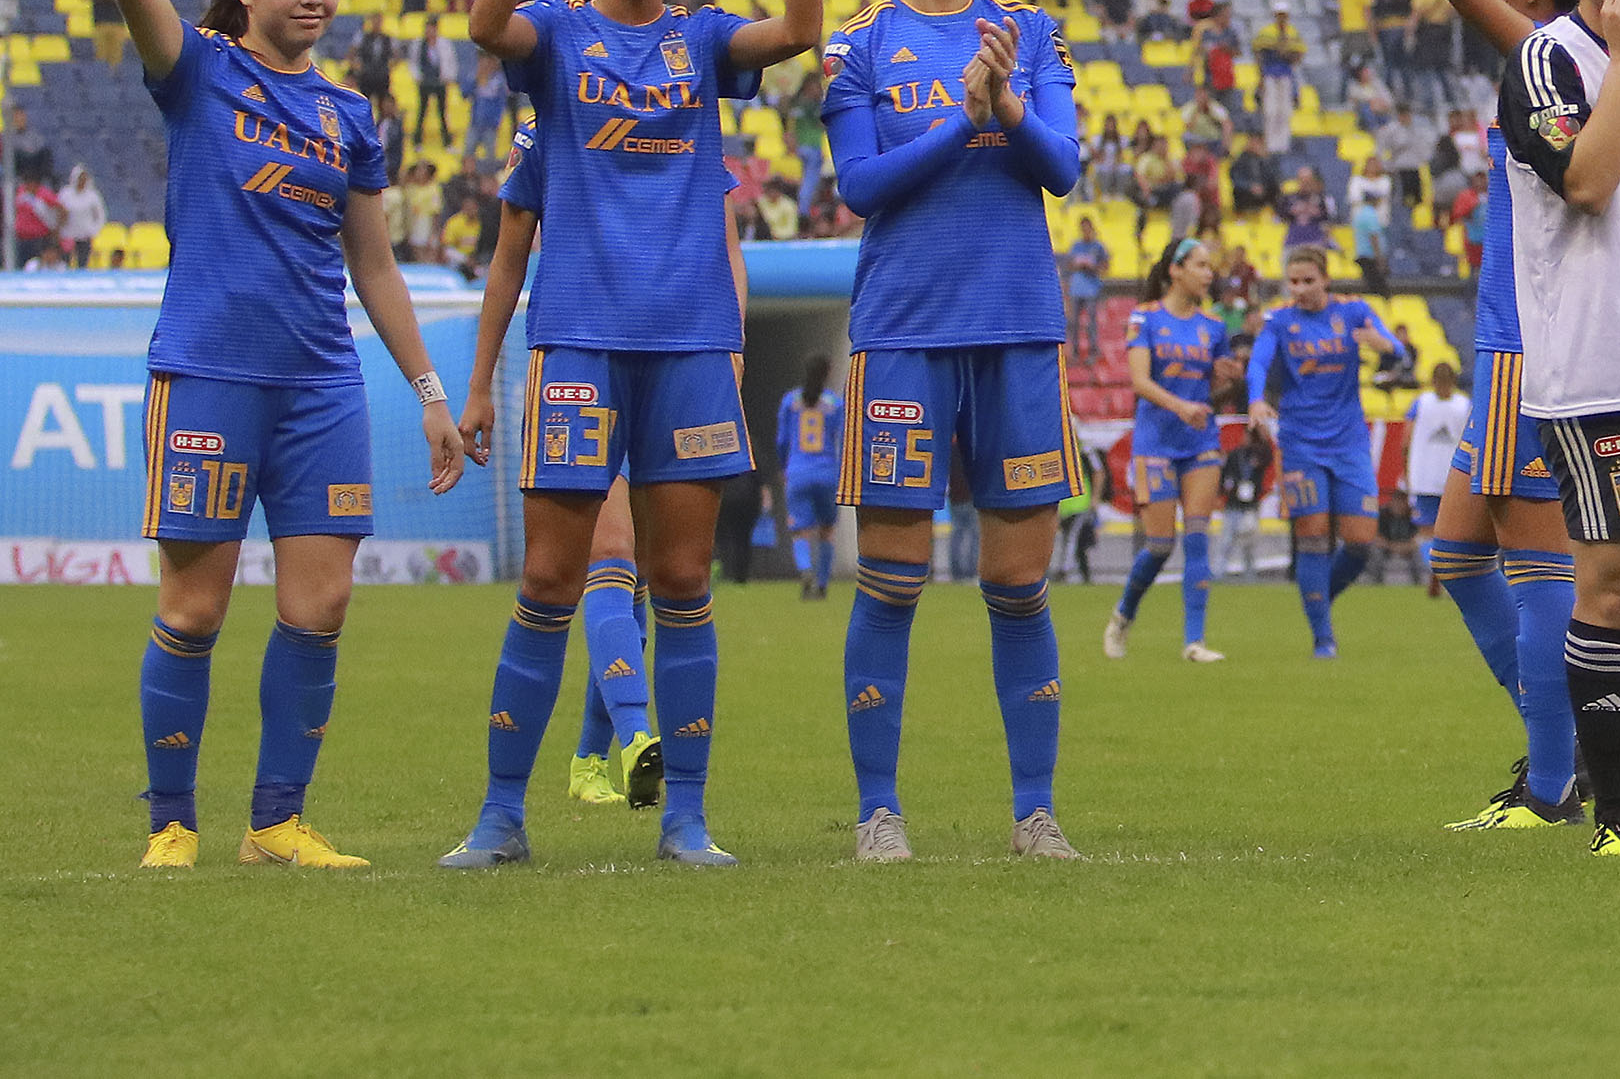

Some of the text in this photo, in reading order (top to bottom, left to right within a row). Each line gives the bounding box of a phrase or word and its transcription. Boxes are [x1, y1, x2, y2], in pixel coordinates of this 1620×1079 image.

[10, 383, 145, 470] AT
[799, 410, 824, 452] 8
[903, 429, 933, 489] 5
[202, 459, 248, 520] 10
